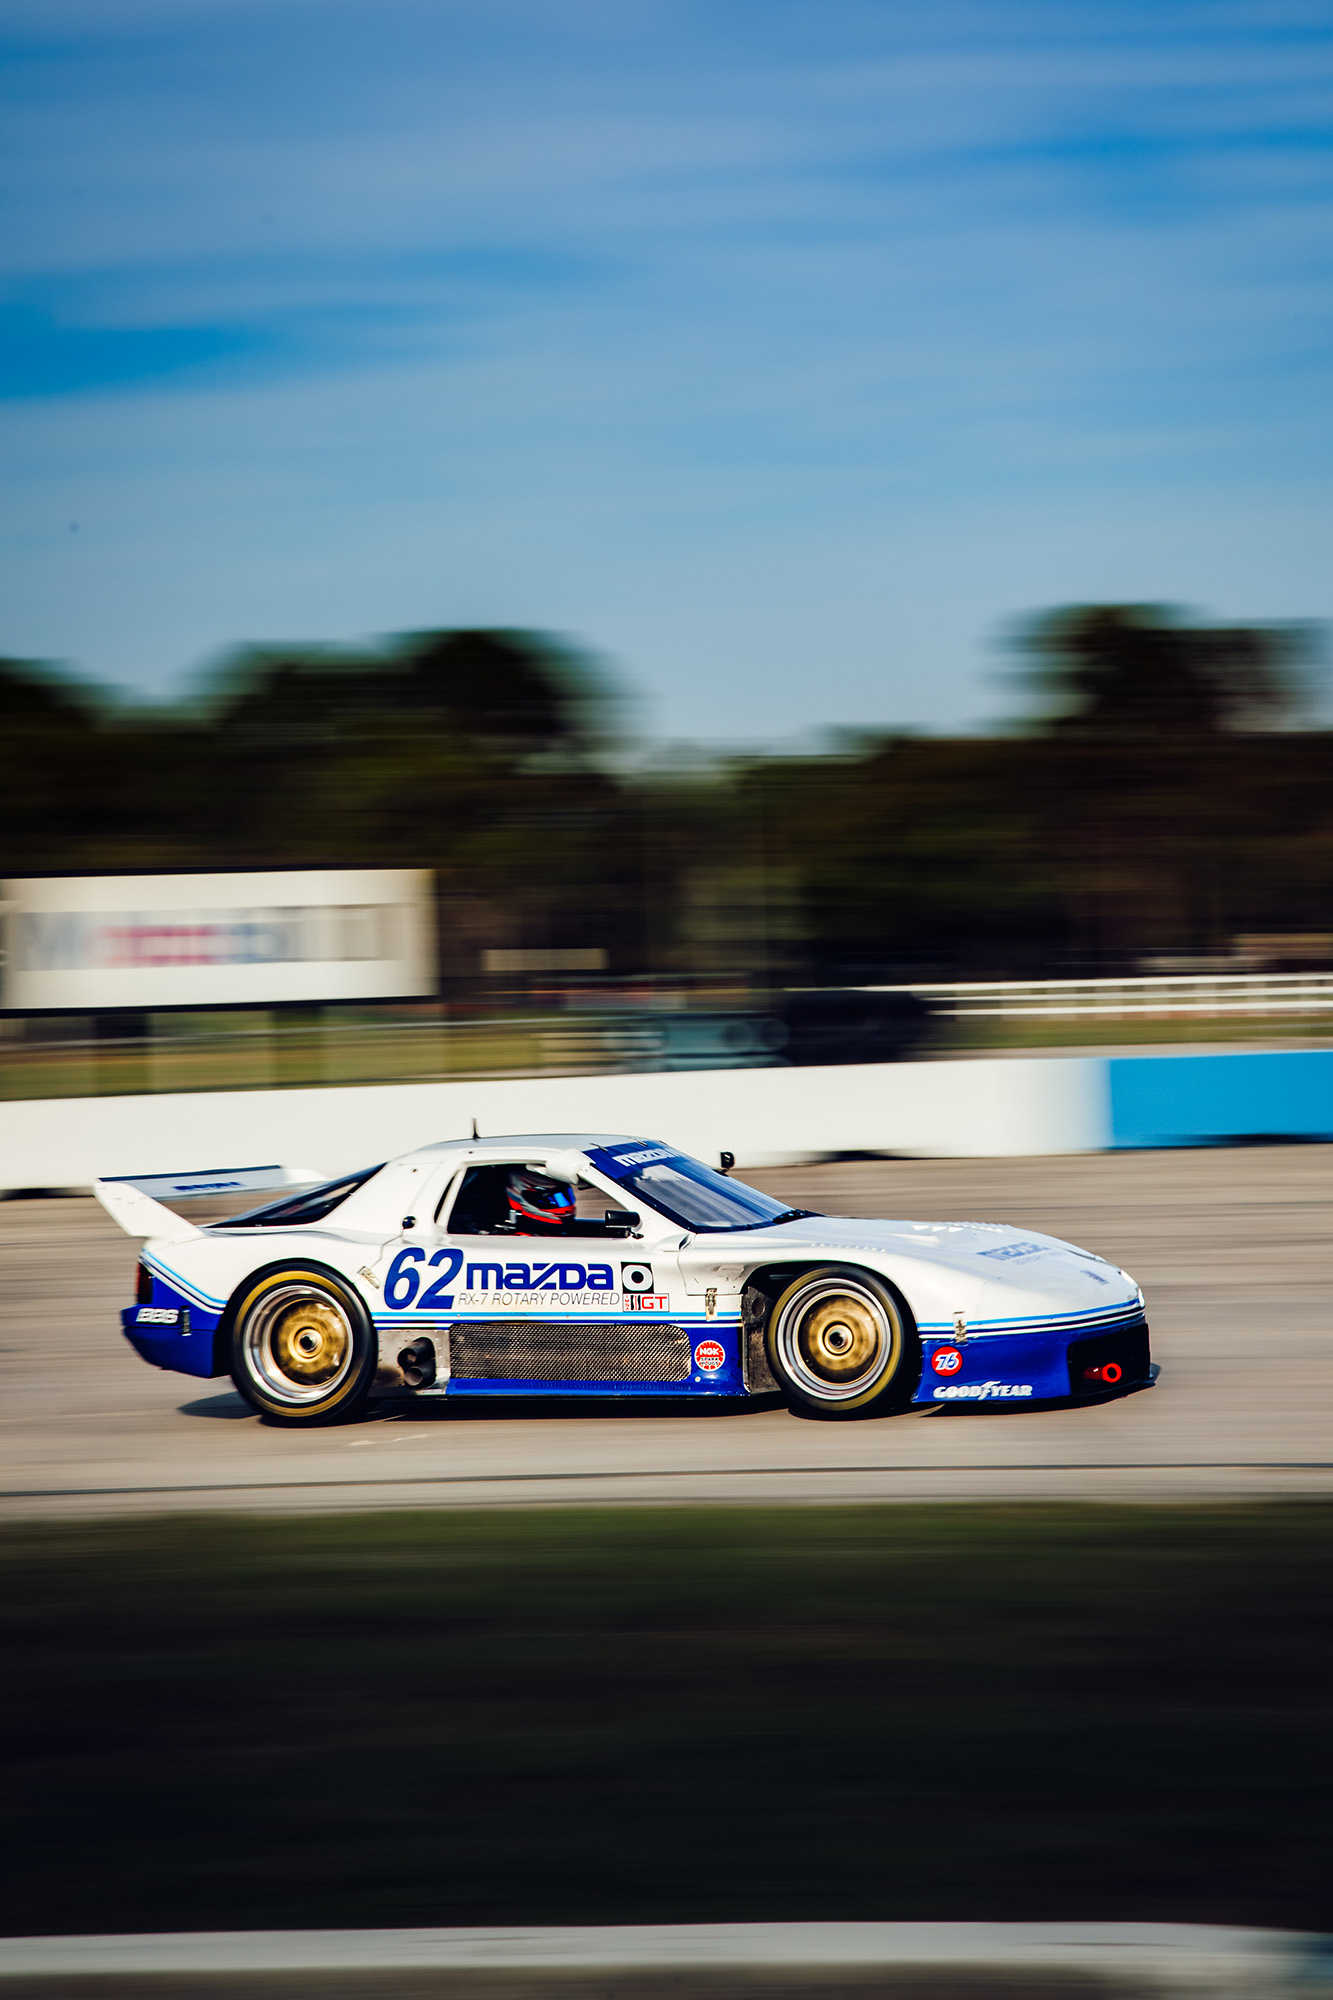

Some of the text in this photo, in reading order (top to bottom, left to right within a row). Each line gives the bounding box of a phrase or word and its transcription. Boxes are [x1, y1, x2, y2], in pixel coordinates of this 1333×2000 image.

[383, 1247, 464, 1310] 62
[458, 1293, 488, 1306] RX-7
[491, 1292, 547, 1306] ROTARY
[549, 1292, 620, 1306] POWERED
[641, 1296, 668, 1310] GT
[136, 1308, 179, 1324] BBS
[699, 1347, 720, 1356] NGK
[935, 1352, 960, 1371] 76
[933, 1380, 1033, 1400] GOODYEAR
